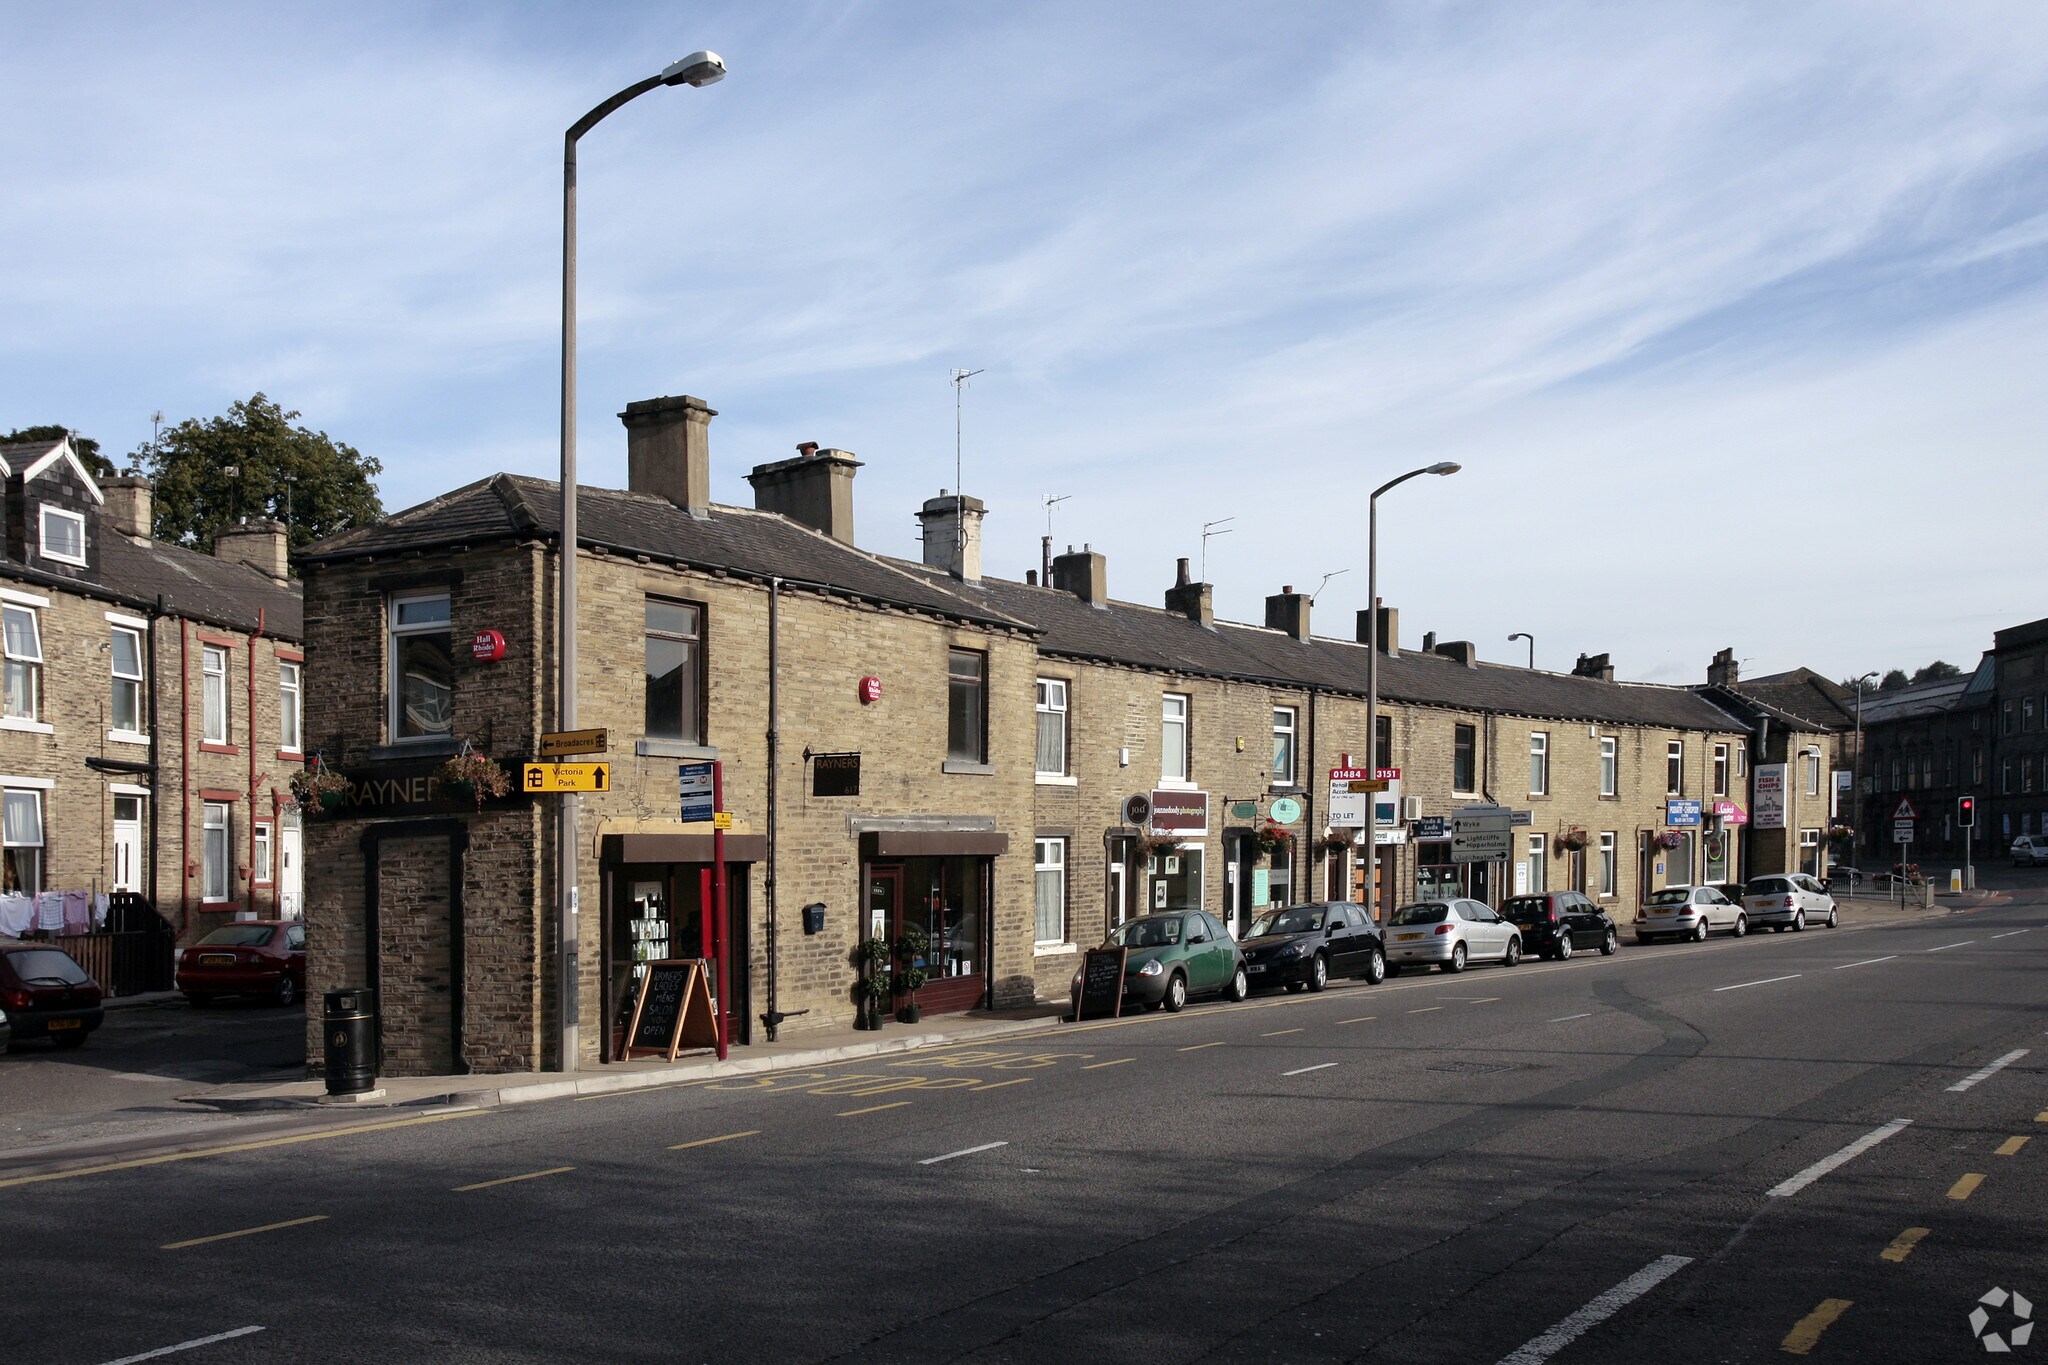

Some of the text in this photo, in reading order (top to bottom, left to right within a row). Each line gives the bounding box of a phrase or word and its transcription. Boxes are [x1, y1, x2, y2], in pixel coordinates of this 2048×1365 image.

[477, 635, 490, 643] Hall
[556, 738, 594, 748] Broadacres
[816, 758, 858, 769] RAYNERS
[552, 767, 583, 776] Victoria
[1333, 770, 1361, 778] 01484
[558, 779, 576, 787] Park
[344, 776, 440, 806] RAYNER
[845, 785, 858, 795] 617
[1180, 805, 1204, 816] photography
[654, 971, 683, 981] RAYNERS
[654, 981, 679, 990] LADIES
[656, 993, 676, 1002] MENS
[649, 1004, 675, 1014] SALON
[643, 1025, 666, 1035] OPEN
[885, 1051, 1096, 1069] BUS
[703, 1073, 983, 1097] STOP
